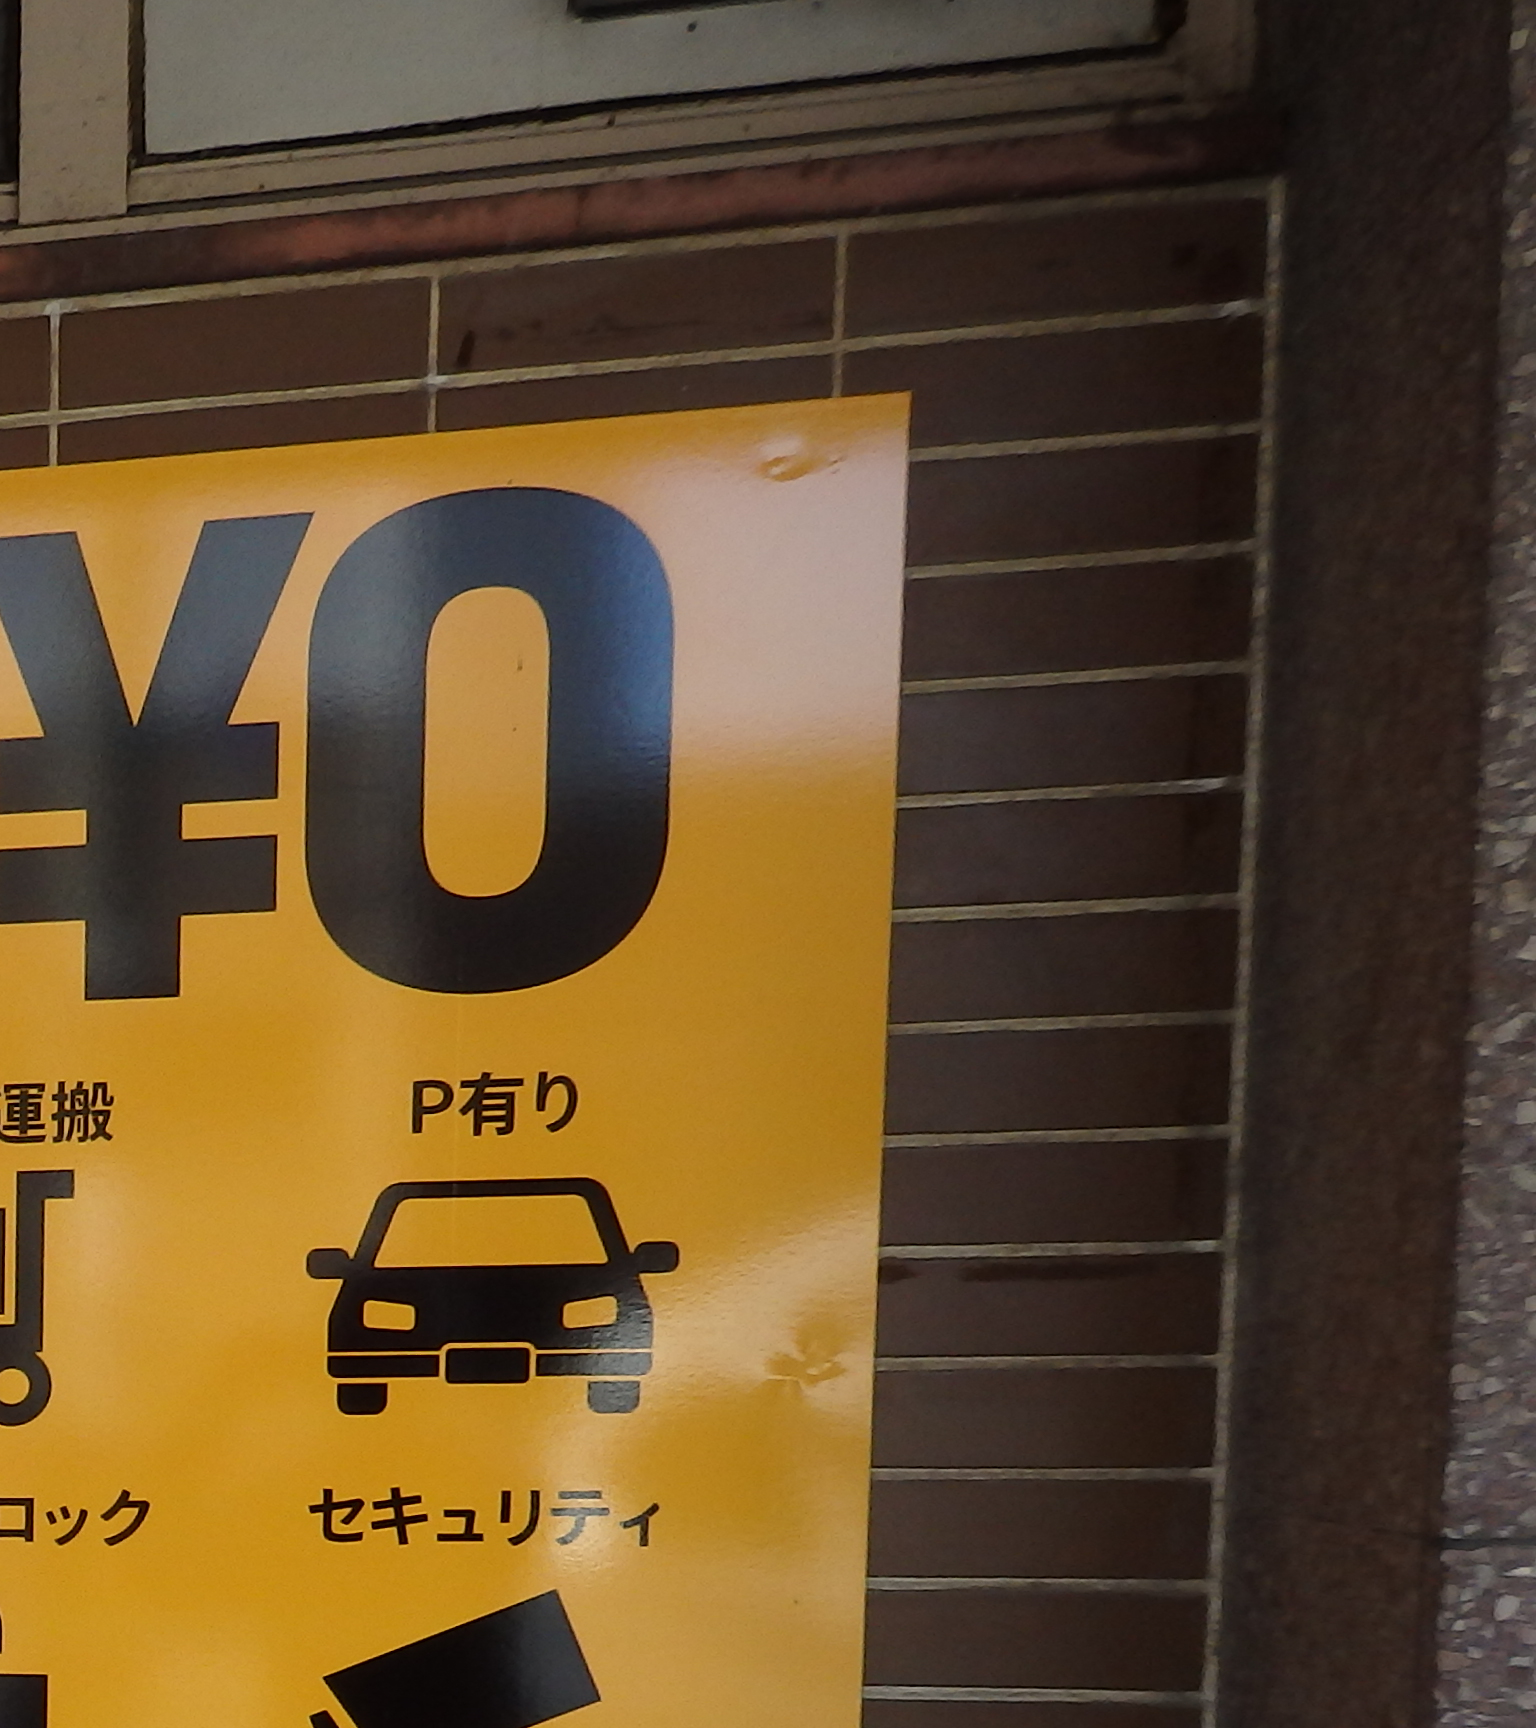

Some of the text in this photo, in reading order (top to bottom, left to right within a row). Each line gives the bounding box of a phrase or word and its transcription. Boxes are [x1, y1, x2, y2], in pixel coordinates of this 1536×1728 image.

[412, 1072, 578, 1136] P有り
[309, 1487, 659, 1546] セキュリティ
